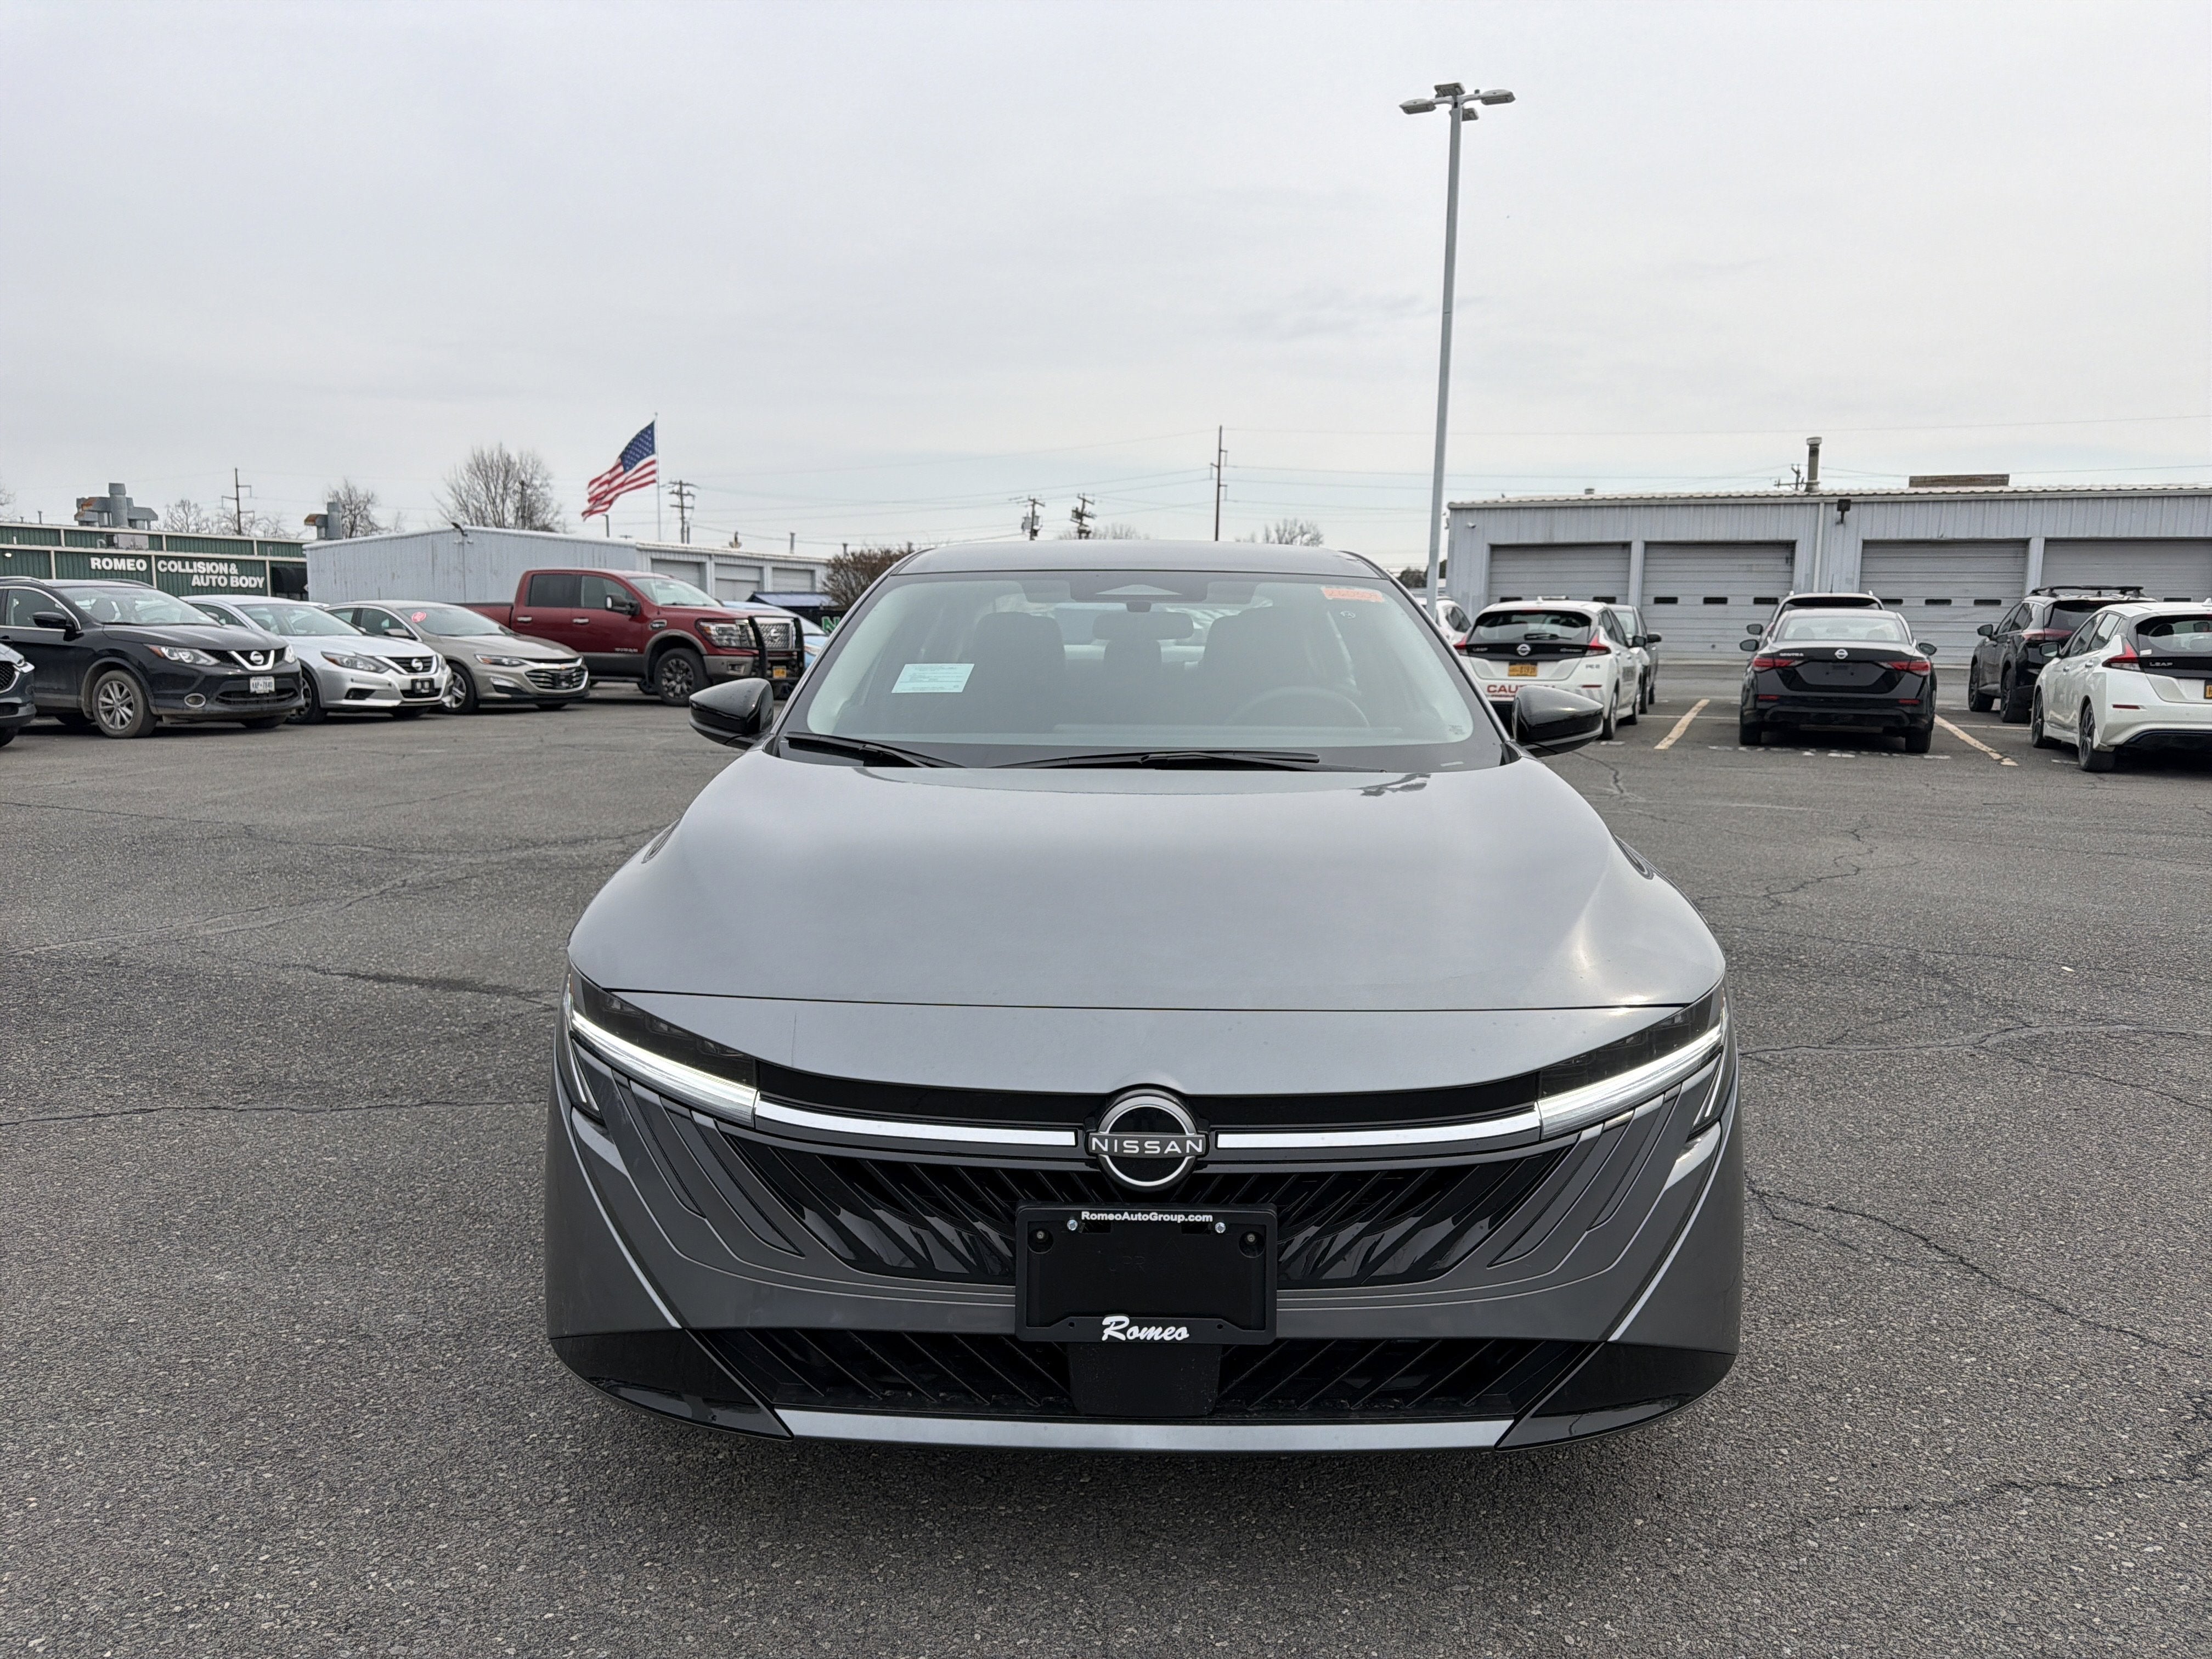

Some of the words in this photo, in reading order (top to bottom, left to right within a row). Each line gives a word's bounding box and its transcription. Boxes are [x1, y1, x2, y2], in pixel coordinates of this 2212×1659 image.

[90, 557, 147, 572] ROMEO
[157, 560, 228, 574] COLLISION
[191, 575, 228, 588] AUTO
[230, 575, 265, 589] BODY
[1092, 1137, 1203, 1154] NISSAN
[1081, 1211, 1213, 1223] RomeoAutoGroup.com
[1101, 1315, 1190, 1341] Romeo
